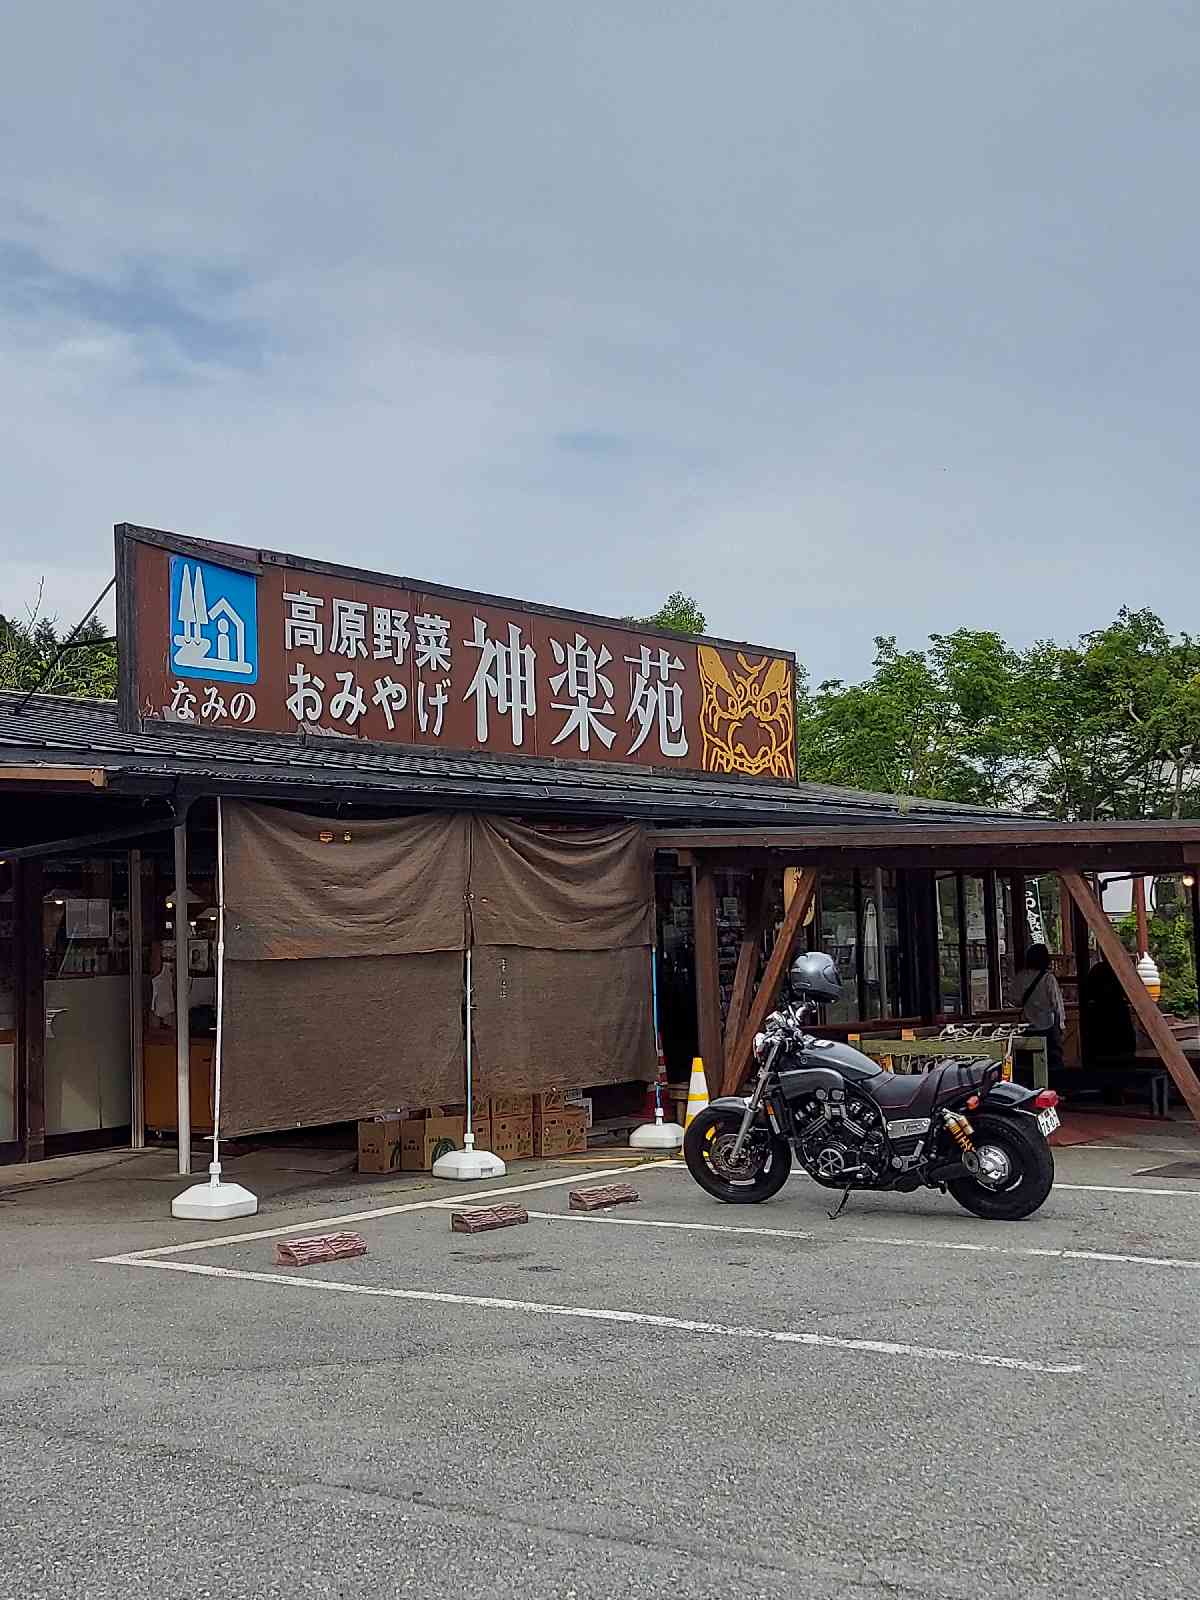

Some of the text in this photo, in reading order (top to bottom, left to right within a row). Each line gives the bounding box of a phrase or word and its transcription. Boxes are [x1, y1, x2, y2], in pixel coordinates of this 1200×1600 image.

[282, 589, 452, 673] 高原野菜
[170, 680, 256, 724] なみの
[286, 663, 452, 737] おみやげ
[462, 616, 689, 757] 神楽苑
